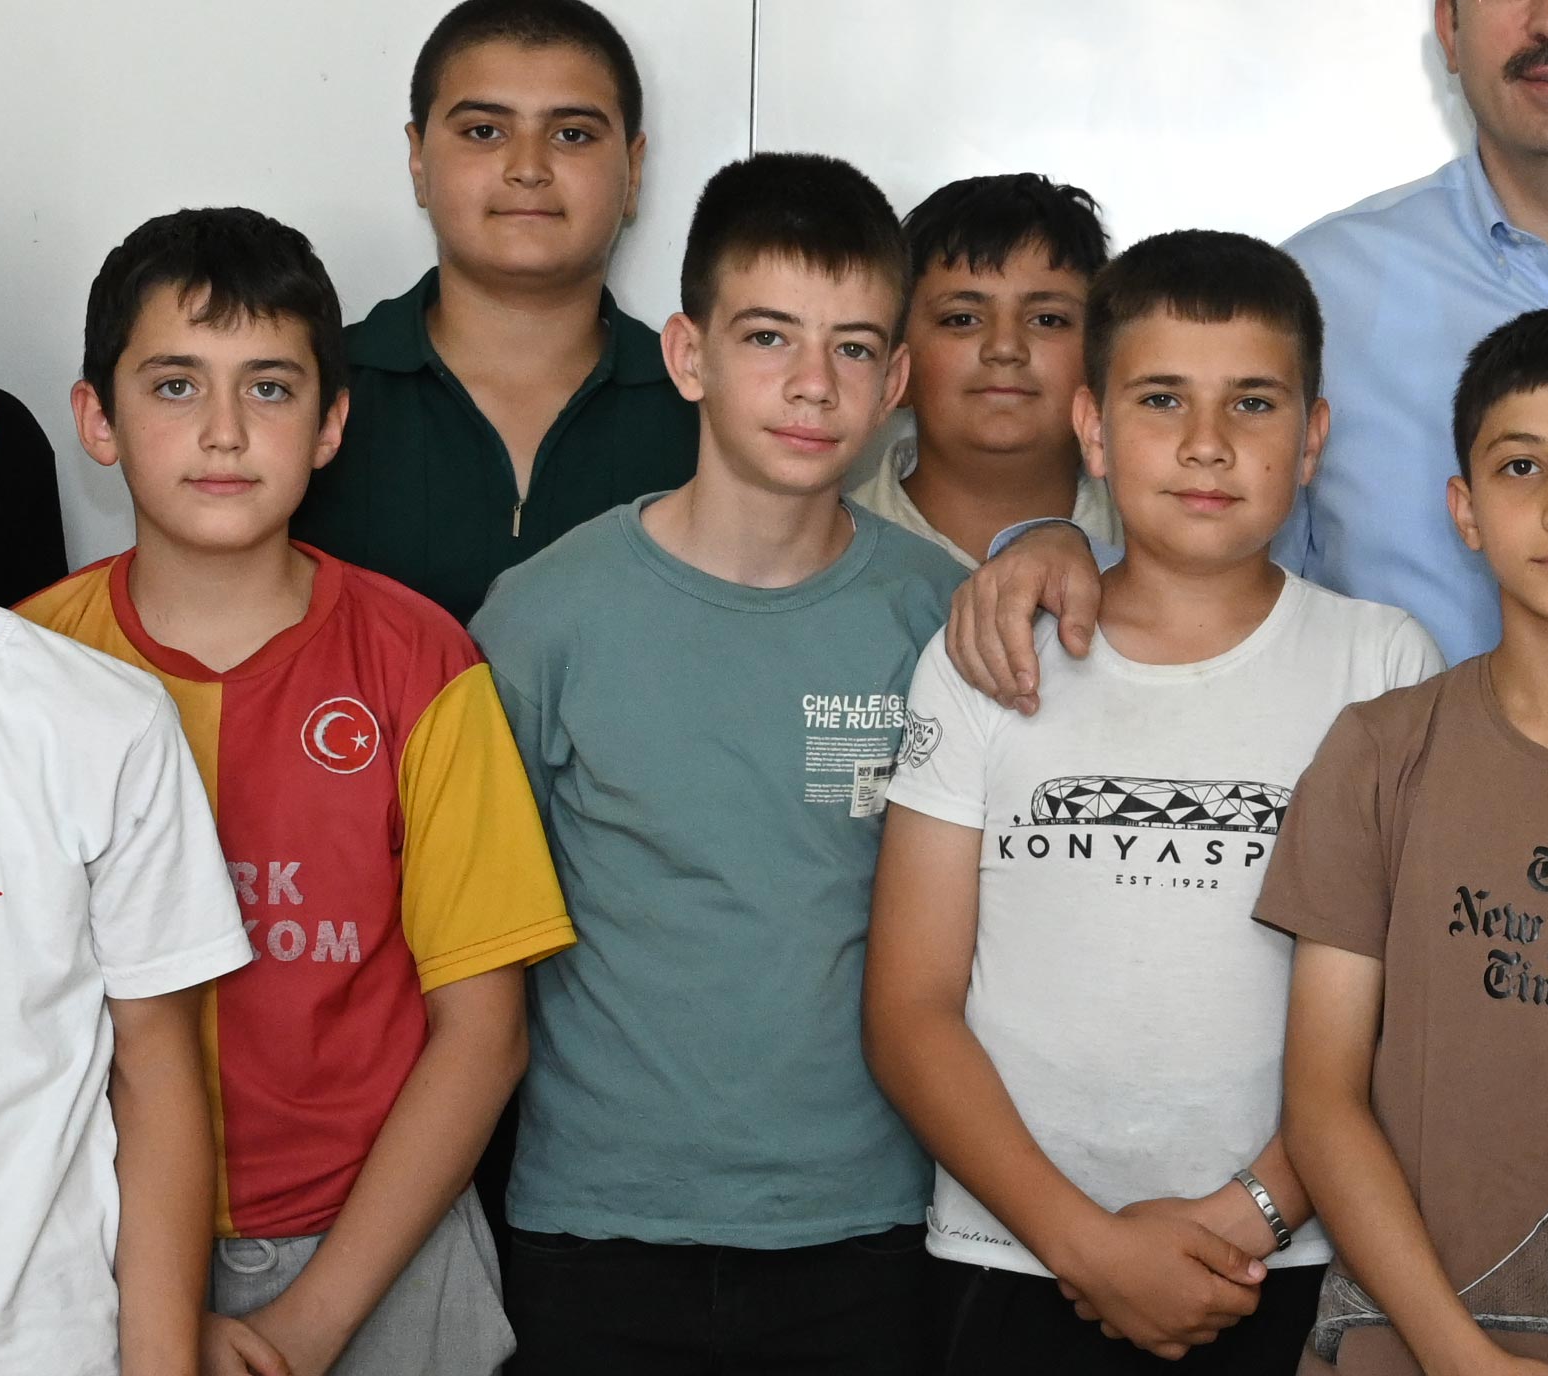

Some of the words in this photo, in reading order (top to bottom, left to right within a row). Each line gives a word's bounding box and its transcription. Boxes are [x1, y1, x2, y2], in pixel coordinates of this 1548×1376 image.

[805, 711, 841, 728] THE
[846, 711, 904, 729] RULES
[1449, 887, 1544, 946] New
